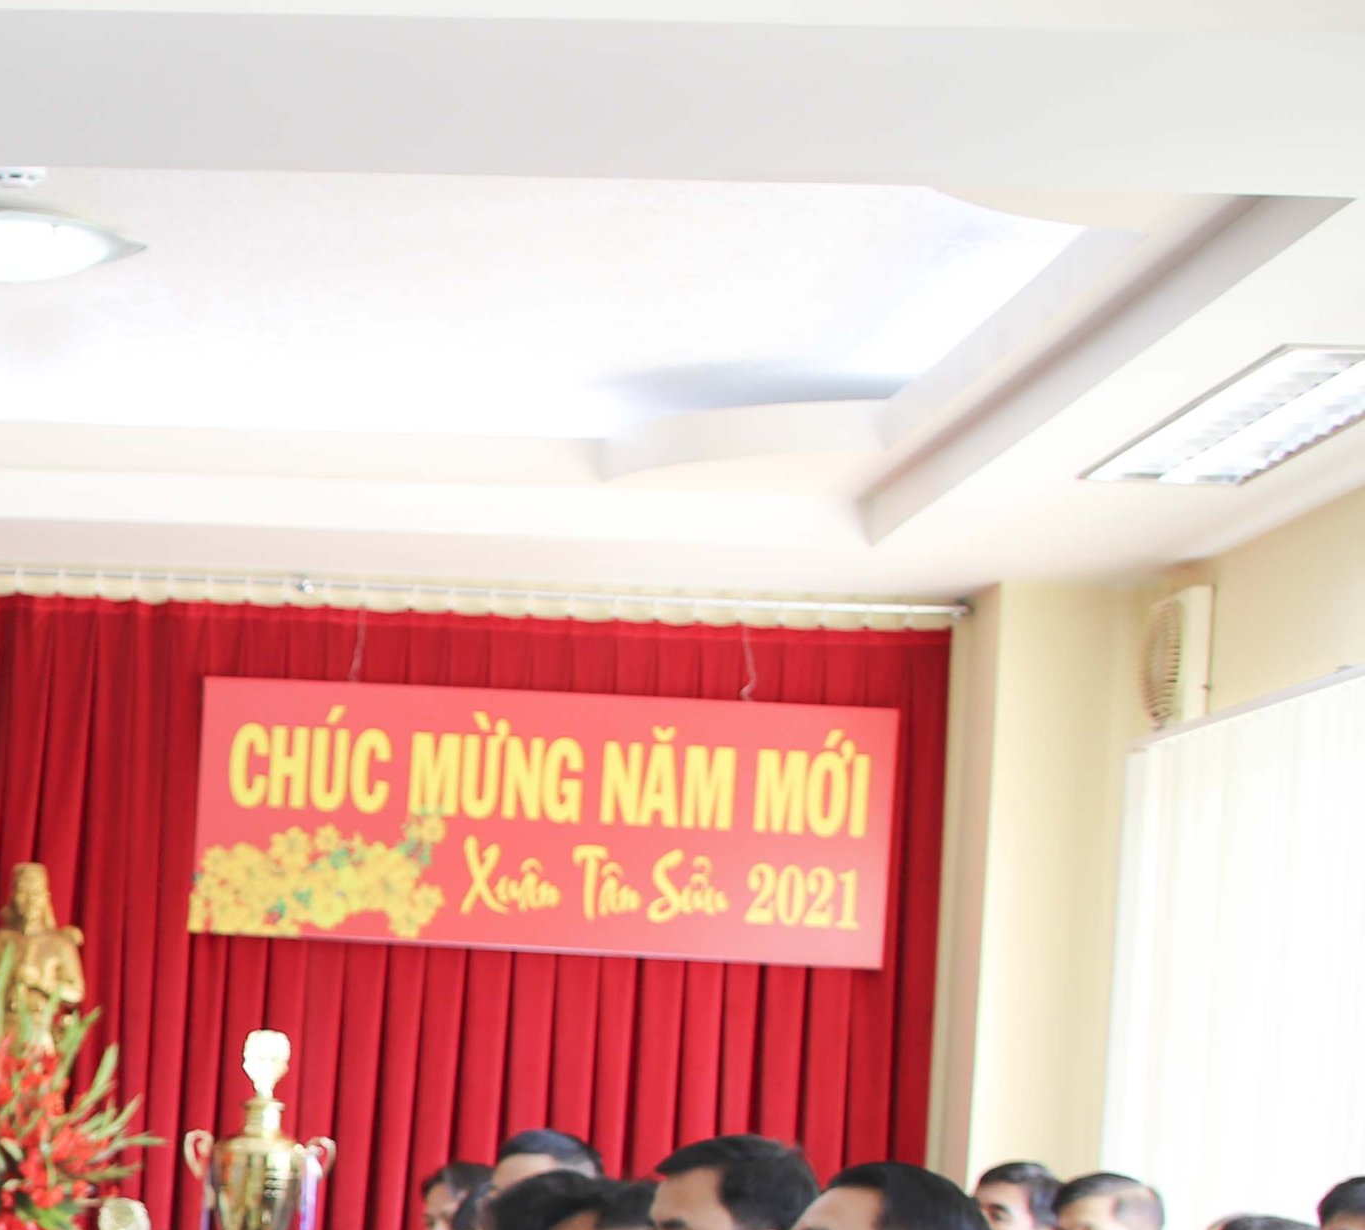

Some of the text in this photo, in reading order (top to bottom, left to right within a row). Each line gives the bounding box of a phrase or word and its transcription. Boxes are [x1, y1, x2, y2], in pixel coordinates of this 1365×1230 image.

[228, 704, 870, 838] CHÚC MỪNG NĂM MỚI
[460, 835, 562, 916] Xuân
[572, 843, 642, 923] Tân
[744, 863, 860, 930] 2021
